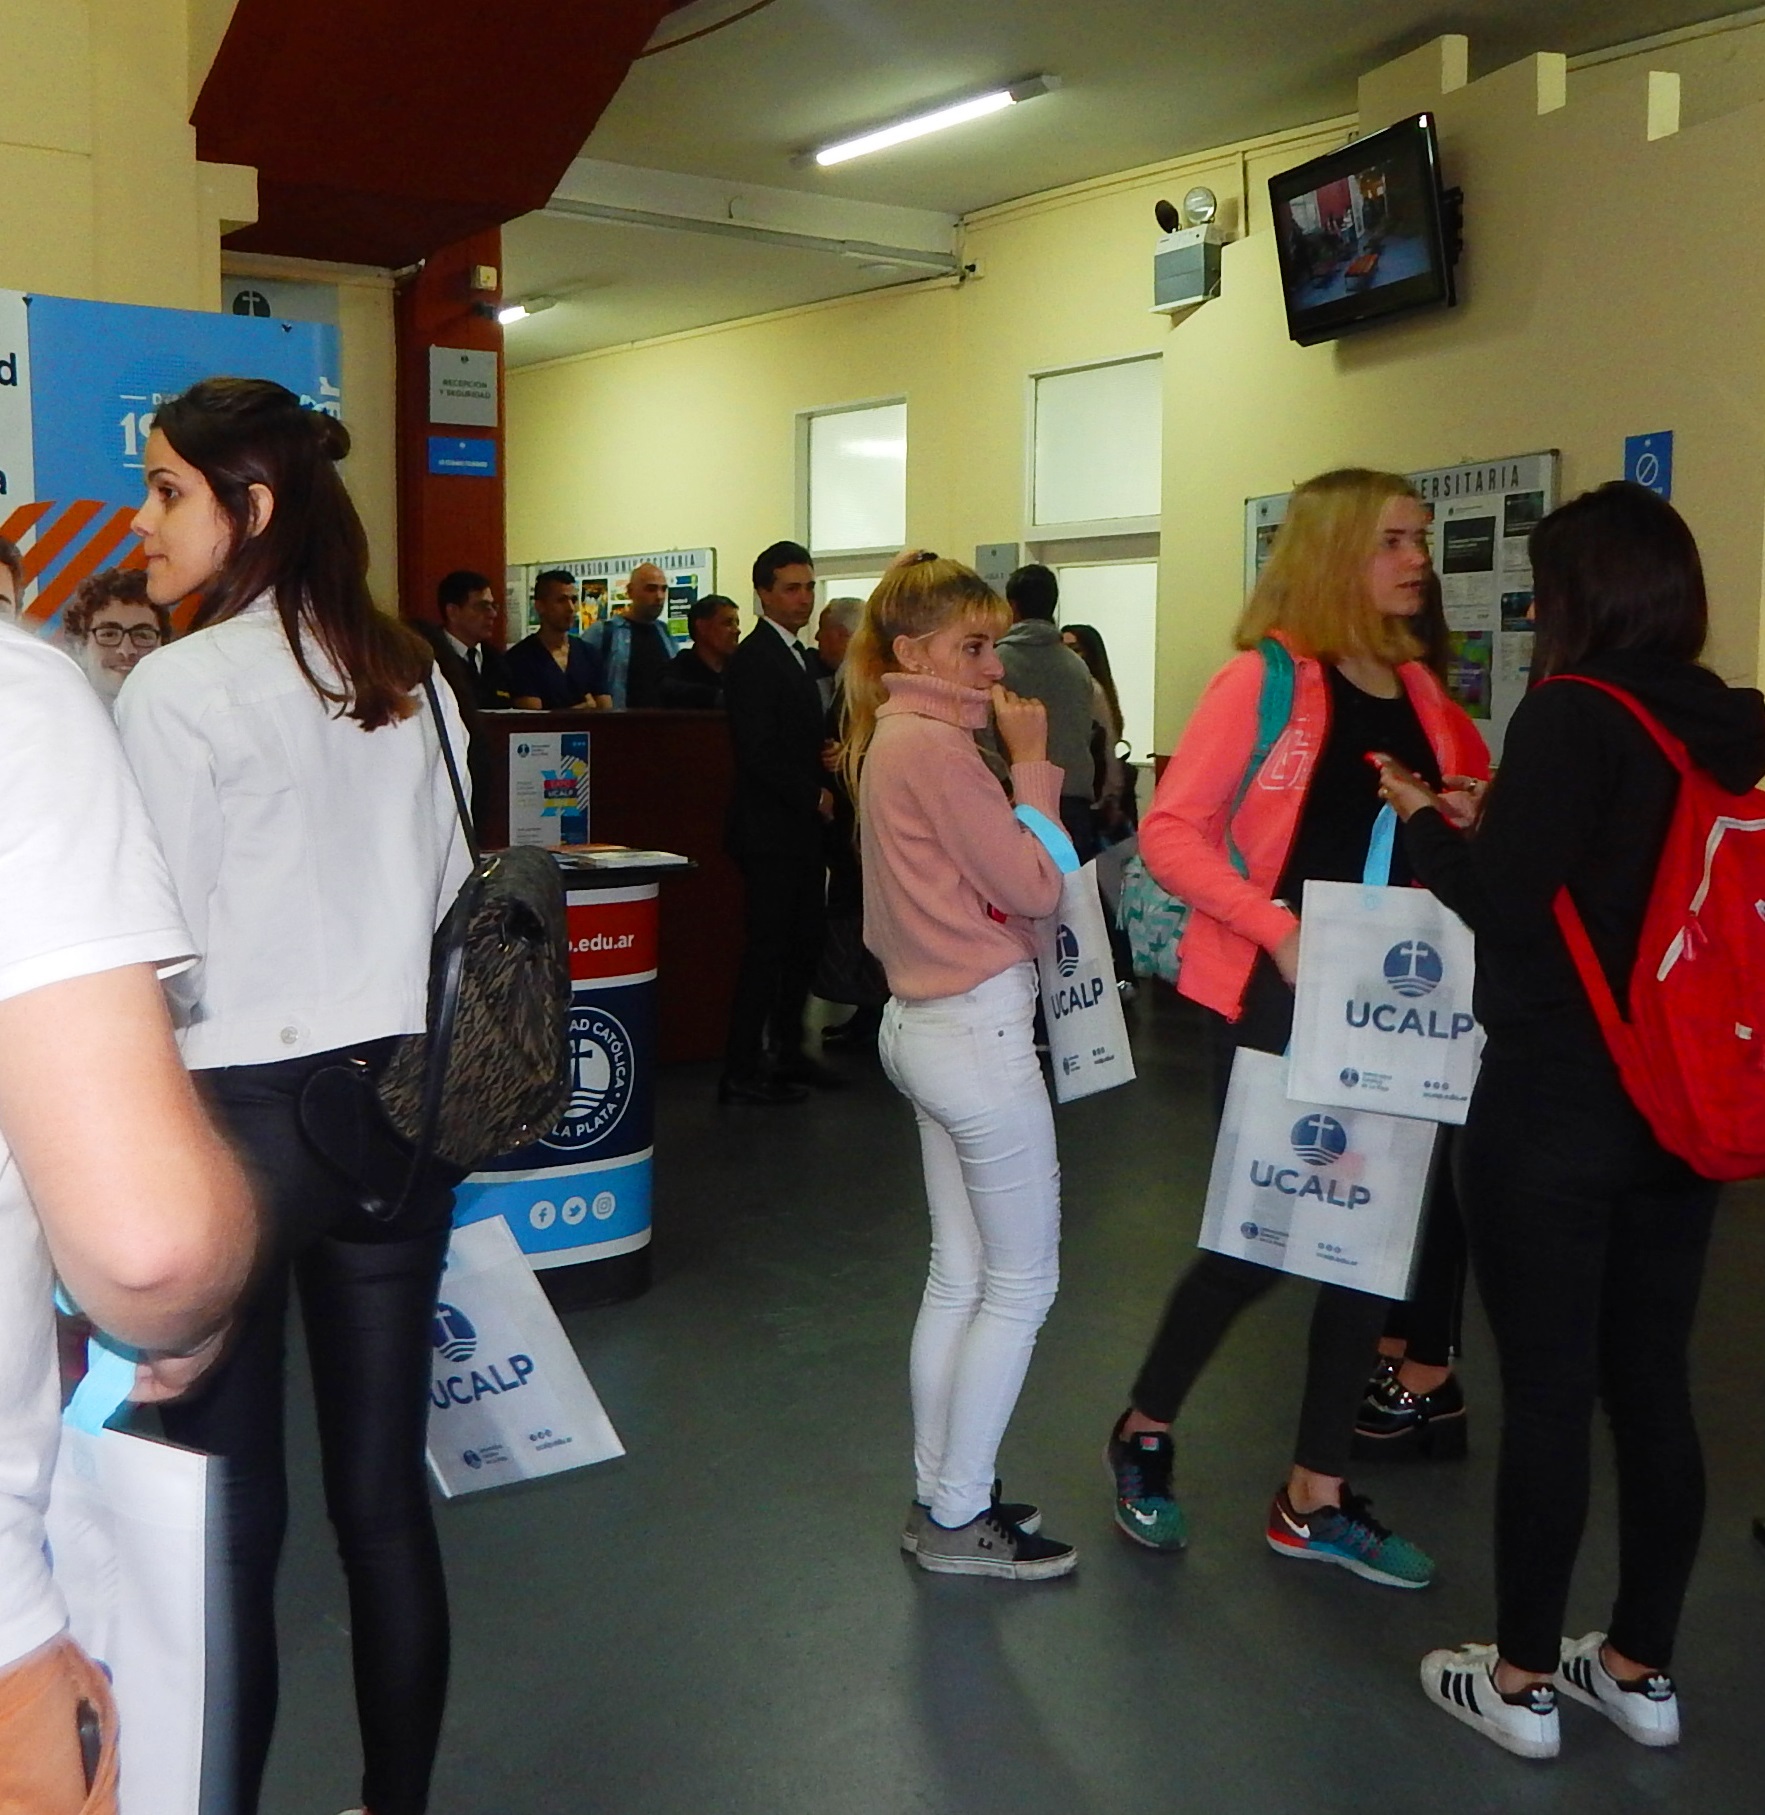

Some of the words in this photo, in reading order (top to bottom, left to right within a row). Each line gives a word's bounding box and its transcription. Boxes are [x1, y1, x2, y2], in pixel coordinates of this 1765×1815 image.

[1051, 977, 1104, 1020] UCALP
[1346, 999, 1475, 1040] UCALP
[552, 1123, 571, 1138] LA
[576, 1102, 618, 1137] PLATA
[1250, 1159, 1371, 1210] UCALP
[430, 1353, 534, 1410] UCALP
